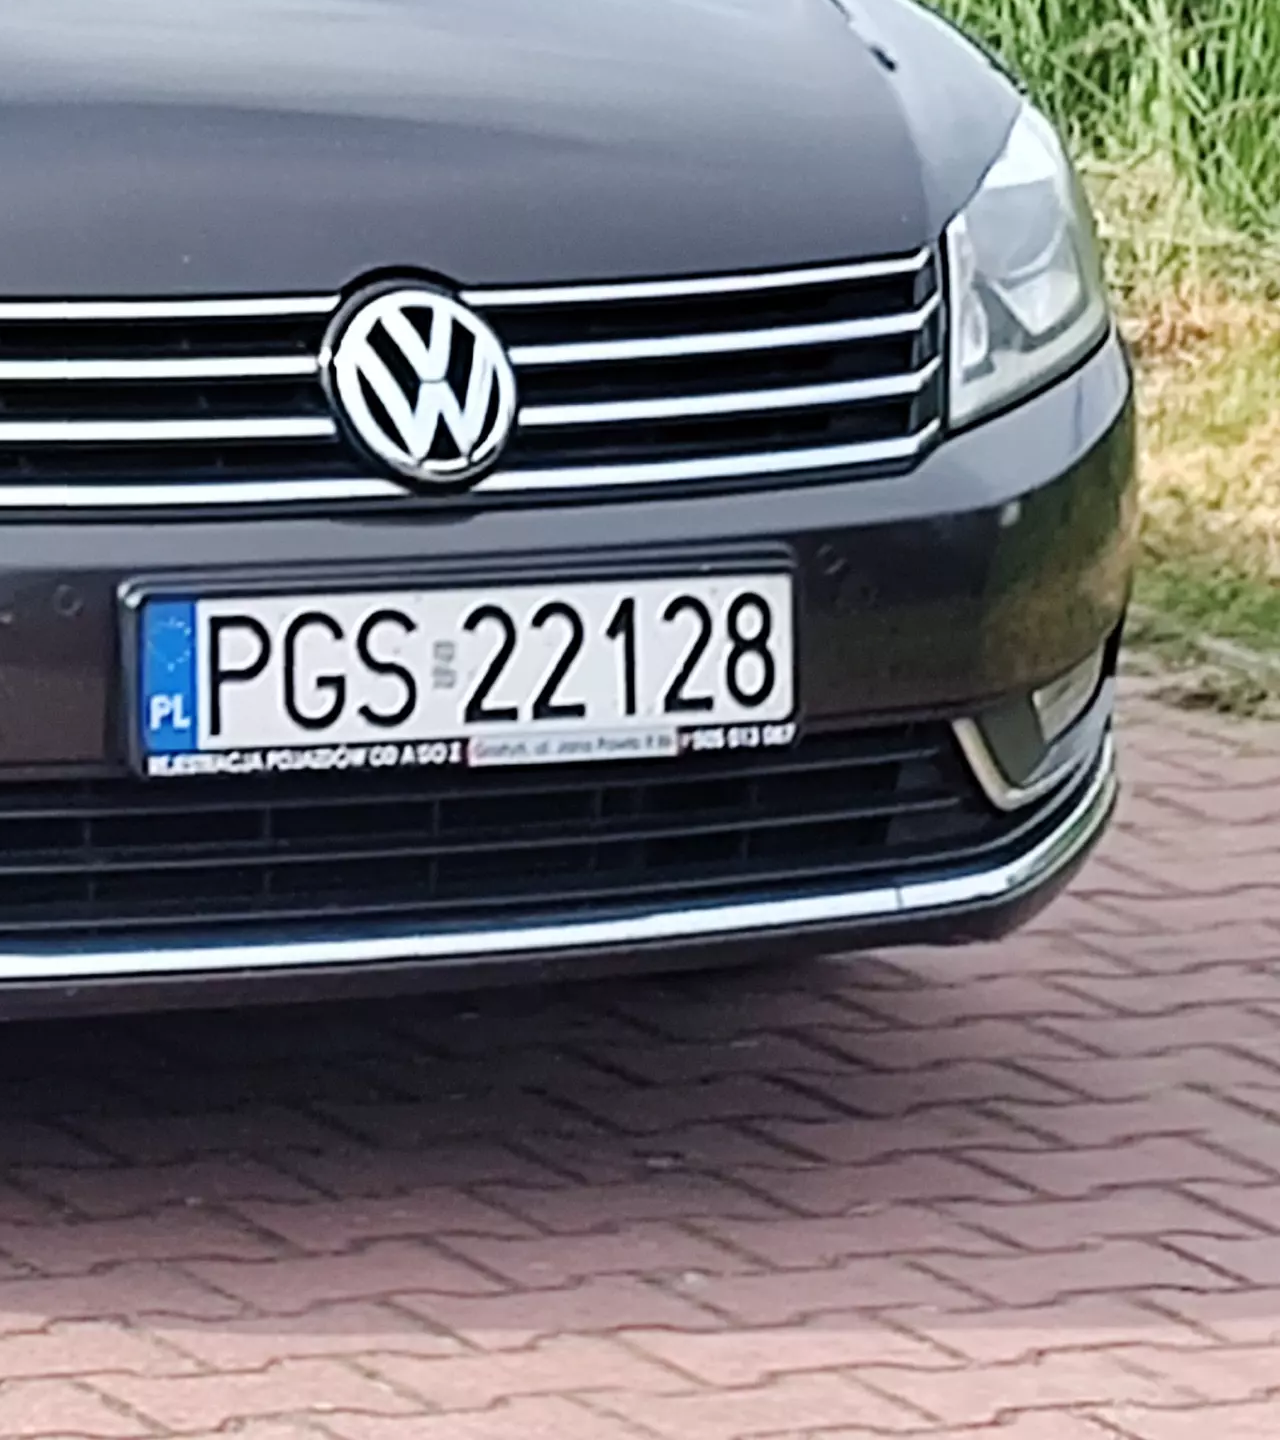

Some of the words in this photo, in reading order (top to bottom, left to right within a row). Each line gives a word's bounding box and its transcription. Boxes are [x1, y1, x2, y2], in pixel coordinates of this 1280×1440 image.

[208, 608, 418, 737] PGS
[461, 591, 776, 722] 22128
[150, 694, 191, 730] PL
